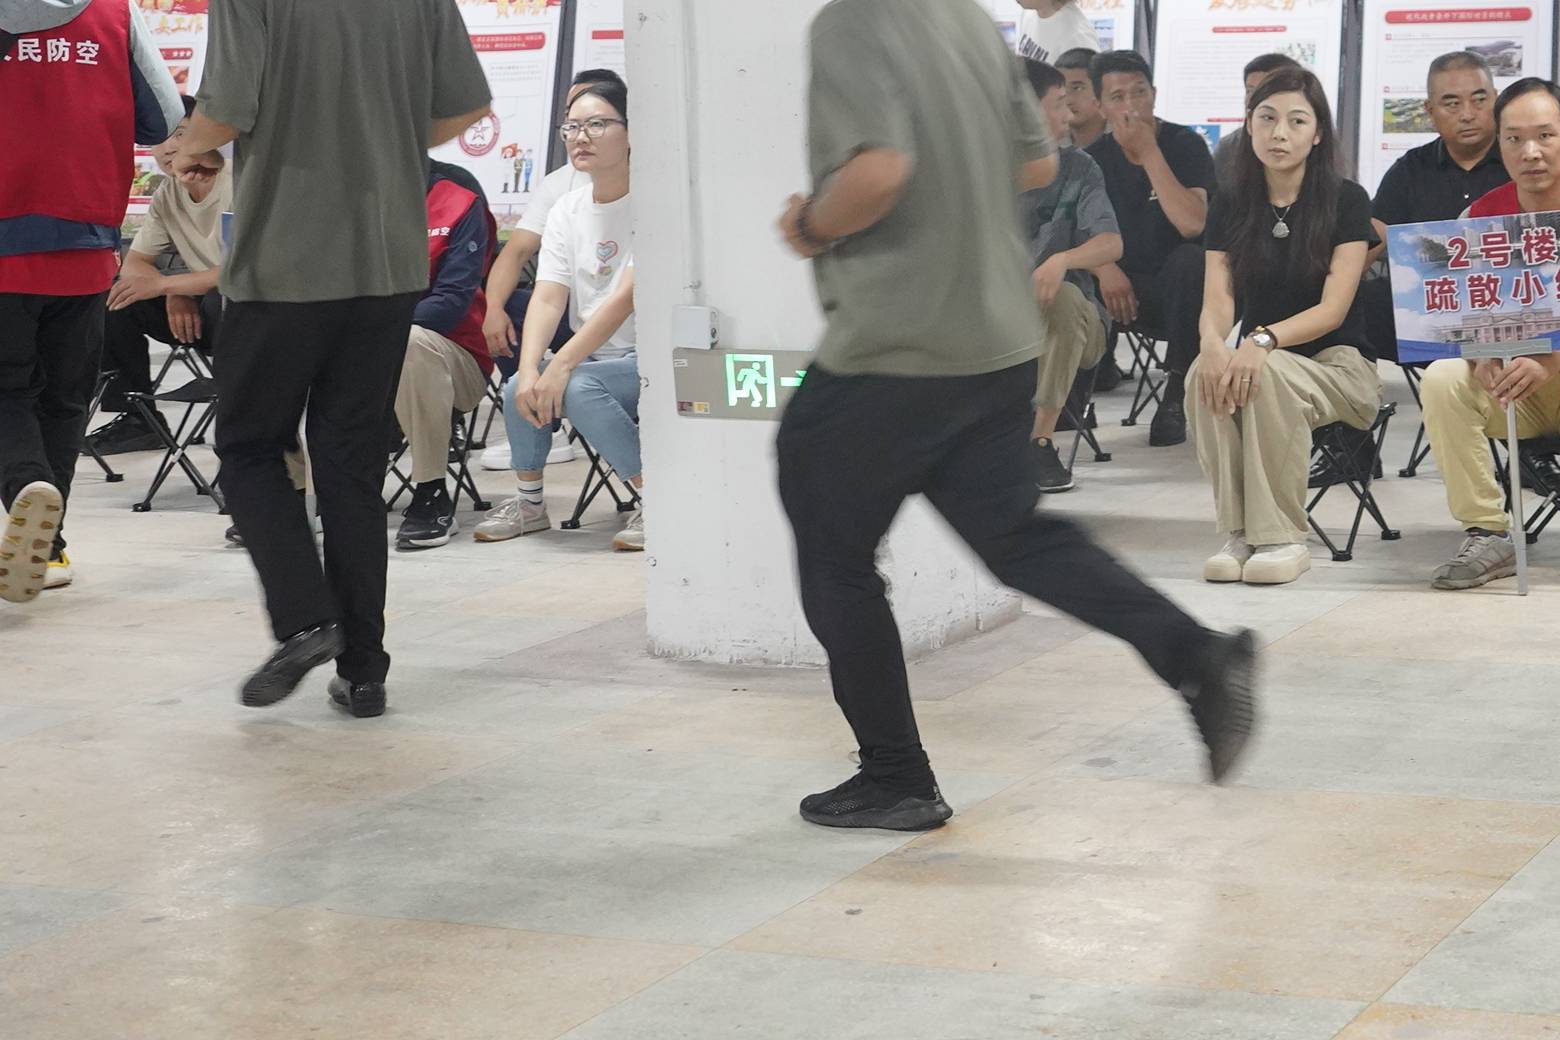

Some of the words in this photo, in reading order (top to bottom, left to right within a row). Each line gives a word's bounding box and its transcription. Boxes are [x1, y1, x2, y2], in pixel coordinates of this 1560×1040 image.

[3, 37, 100, 65] 民防空
[1447, 226, 1558, 270] 2号楼
